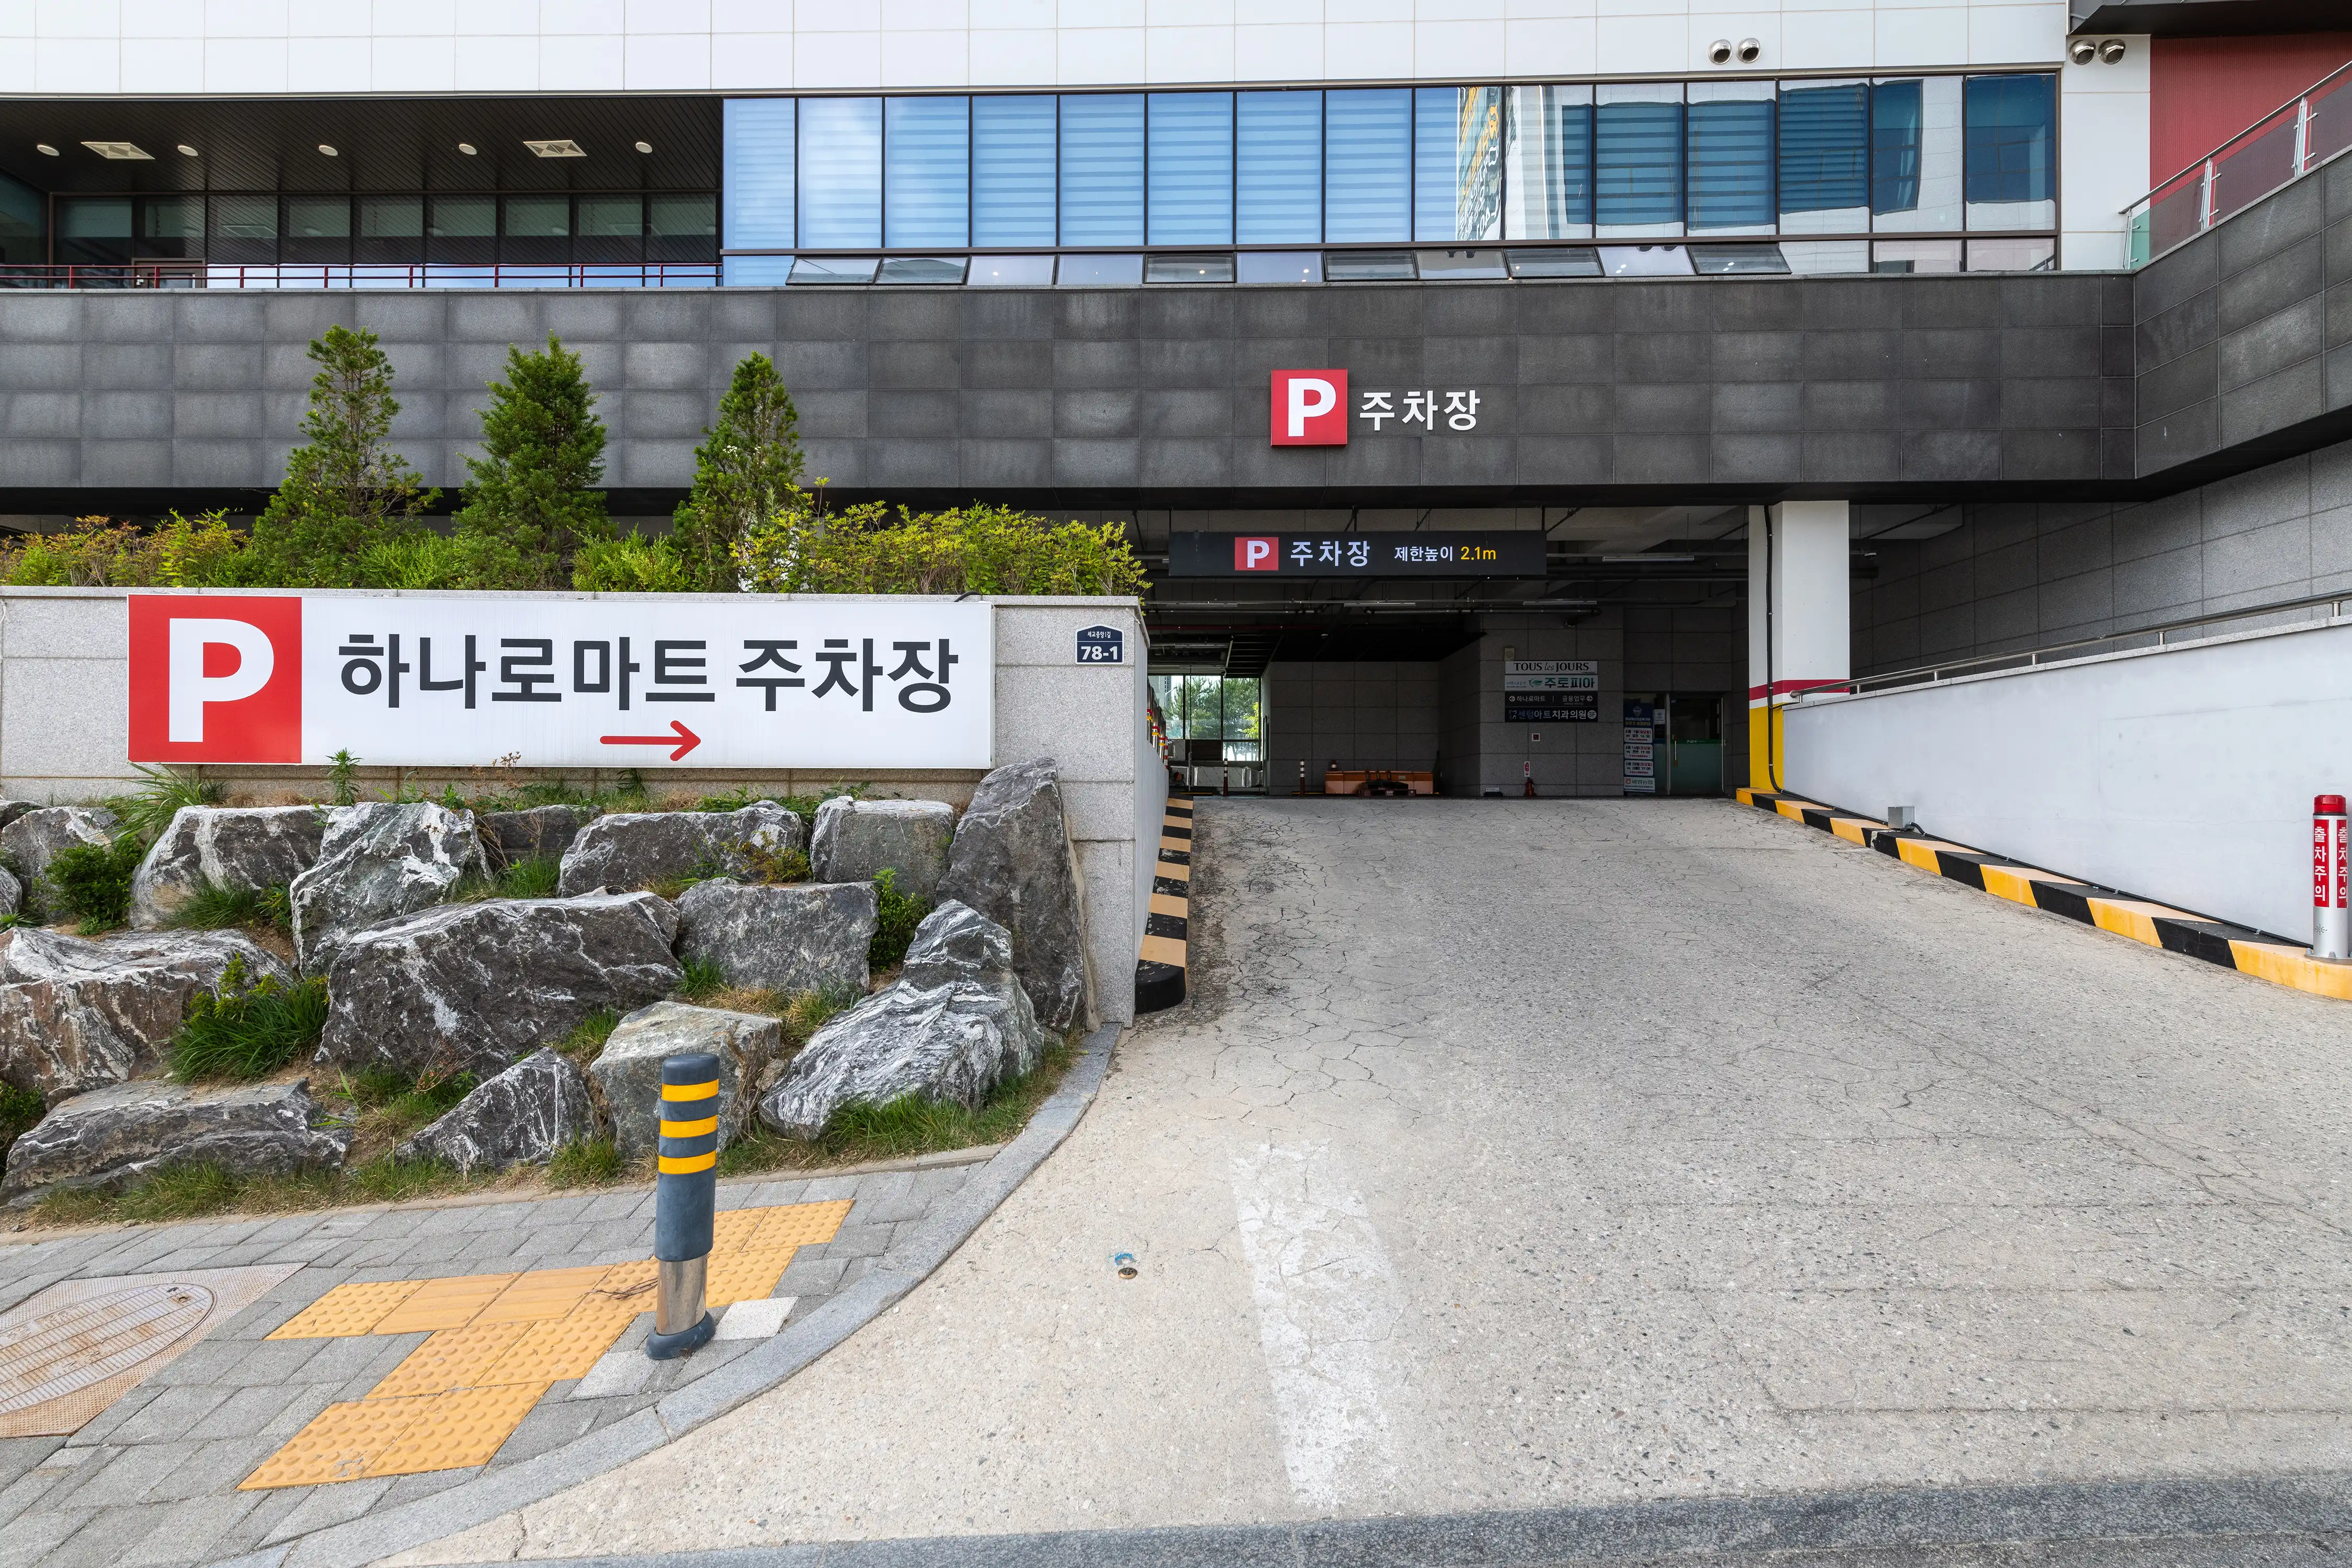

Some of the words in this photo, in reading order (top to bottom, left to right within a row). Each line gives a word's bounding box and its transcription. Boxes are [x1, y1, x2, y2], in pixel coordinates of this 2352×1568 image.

[1288, 378, 1336, 437] P
[1359, 390, 1480, 431] 주차장
[1247, 540, 1270, 568] P
[1290, 541, 1370, 567] 주차장
[1394, 546, 1452, 562] 제한높이
[1460, 547, 1496, 560] 2.1m
[1081, 646, 1117, 660] 78-1
[1514, 663, 1542, 671] TOUS
[1544, 662, 1555, 671] les
[1555, 663, 1589, 673] JOURS
[169, 618, 274, 742] P
[339, 634, 715, 710] 하나로마트
[736, 638, 959, 713] 주차장
[1544, 677, 1595, 688] 주토피아
